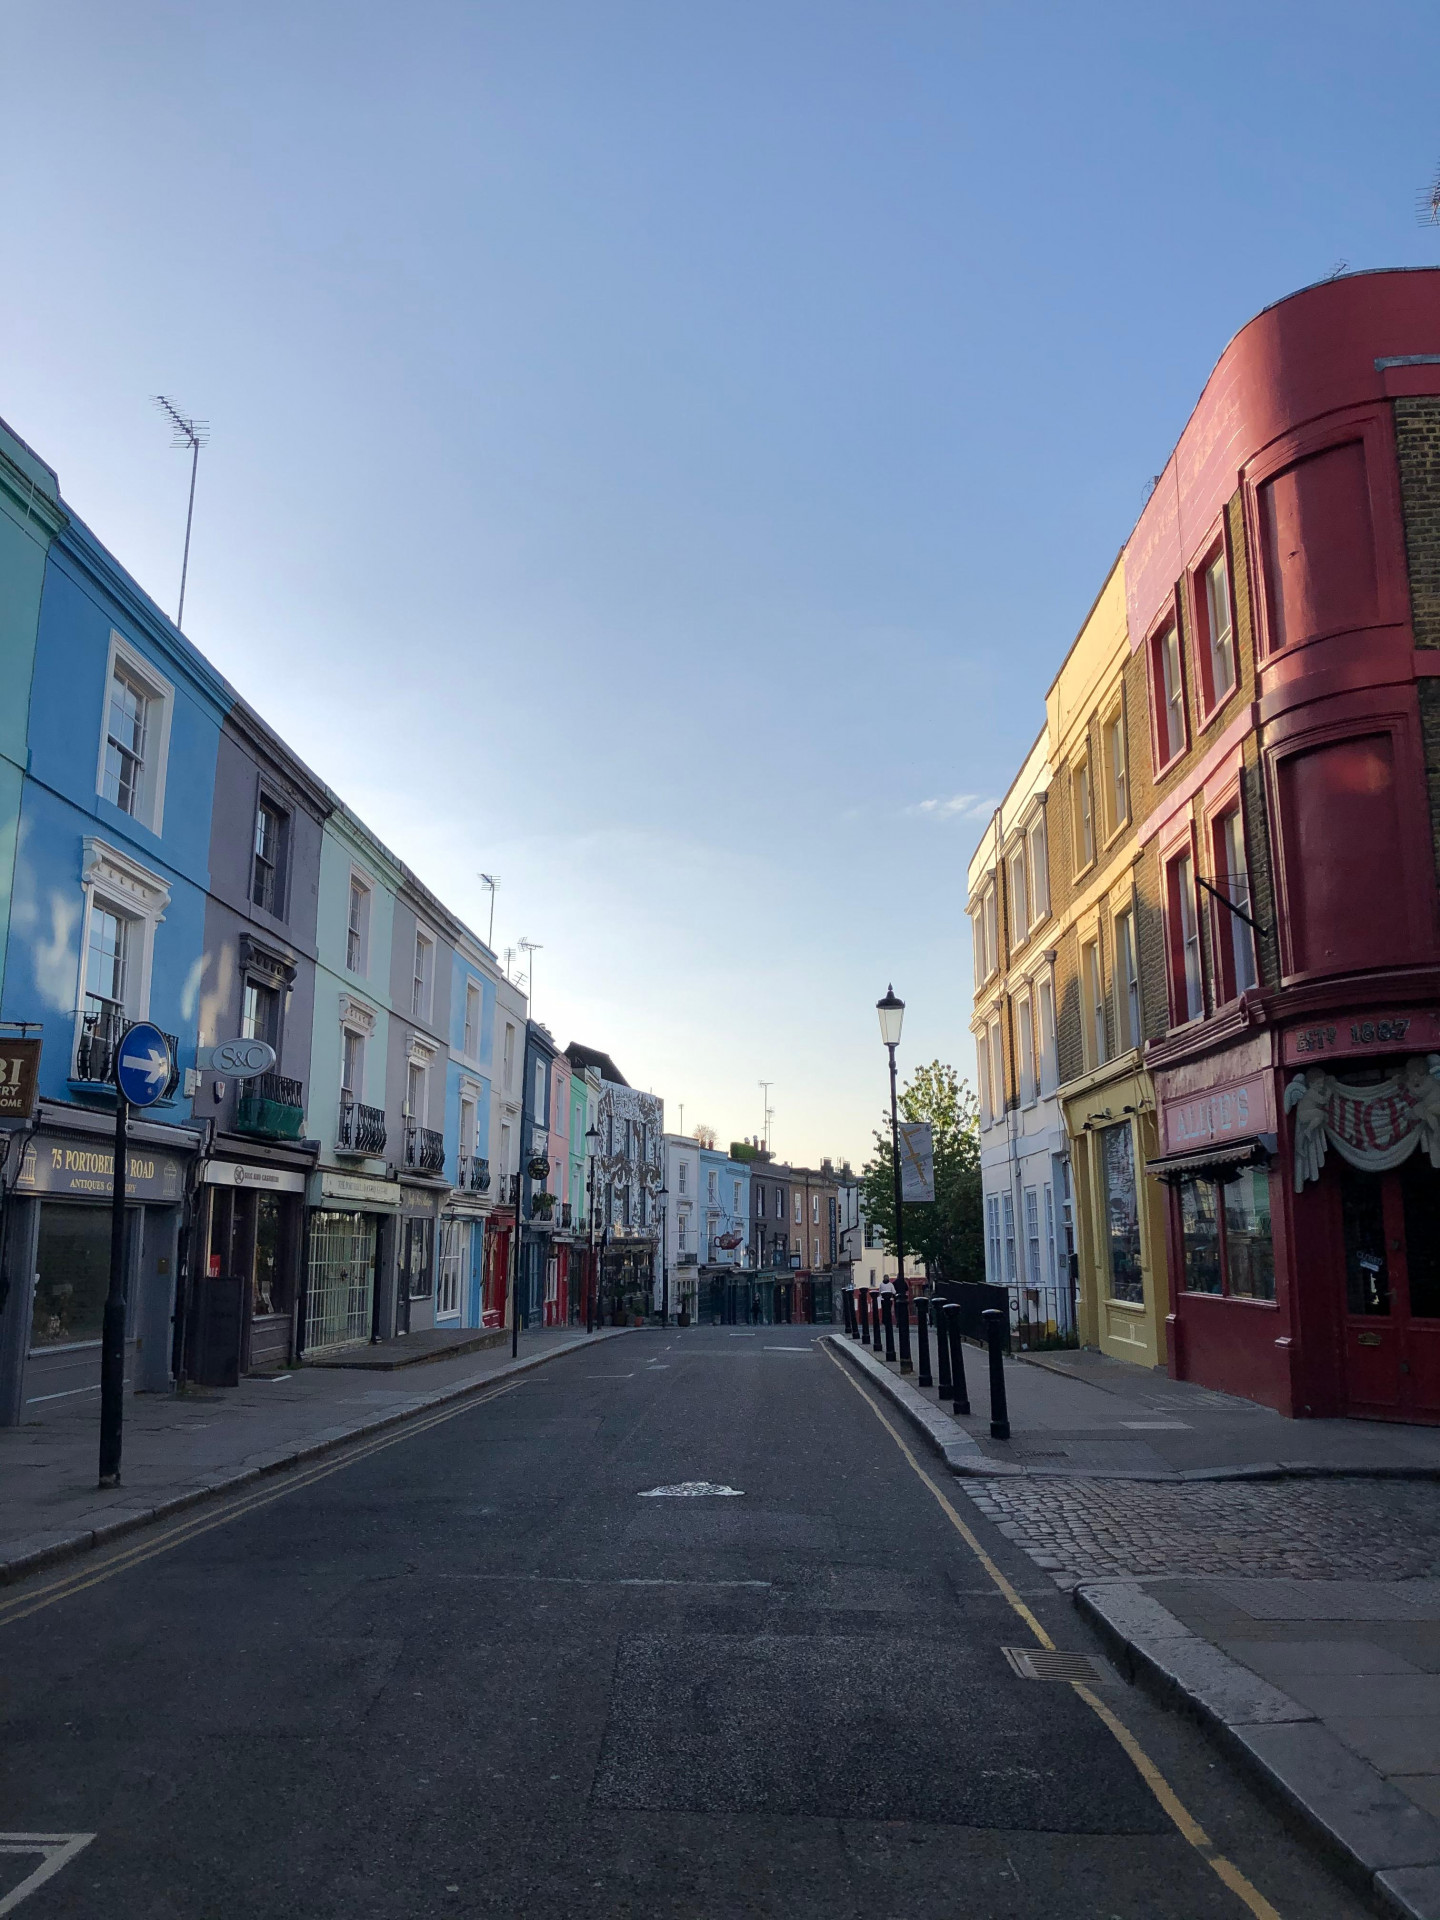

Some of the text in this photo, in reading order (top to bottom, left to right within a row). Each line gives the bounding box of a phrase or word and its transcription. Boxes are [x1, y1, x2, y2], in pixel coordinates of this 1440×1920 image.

[1350, 1019, 1411, 1043] 1887
[221, 1046, 264, 1070] S&C
[0, 1086, 19, 1096] RY
[1176, 1088, 1249, 1142] ALICE'S
[51, 1148, 155, 1179] 75 PORTOBEL ROAD
[70, 1179, 137, 1194] ANTIQUES GERY
